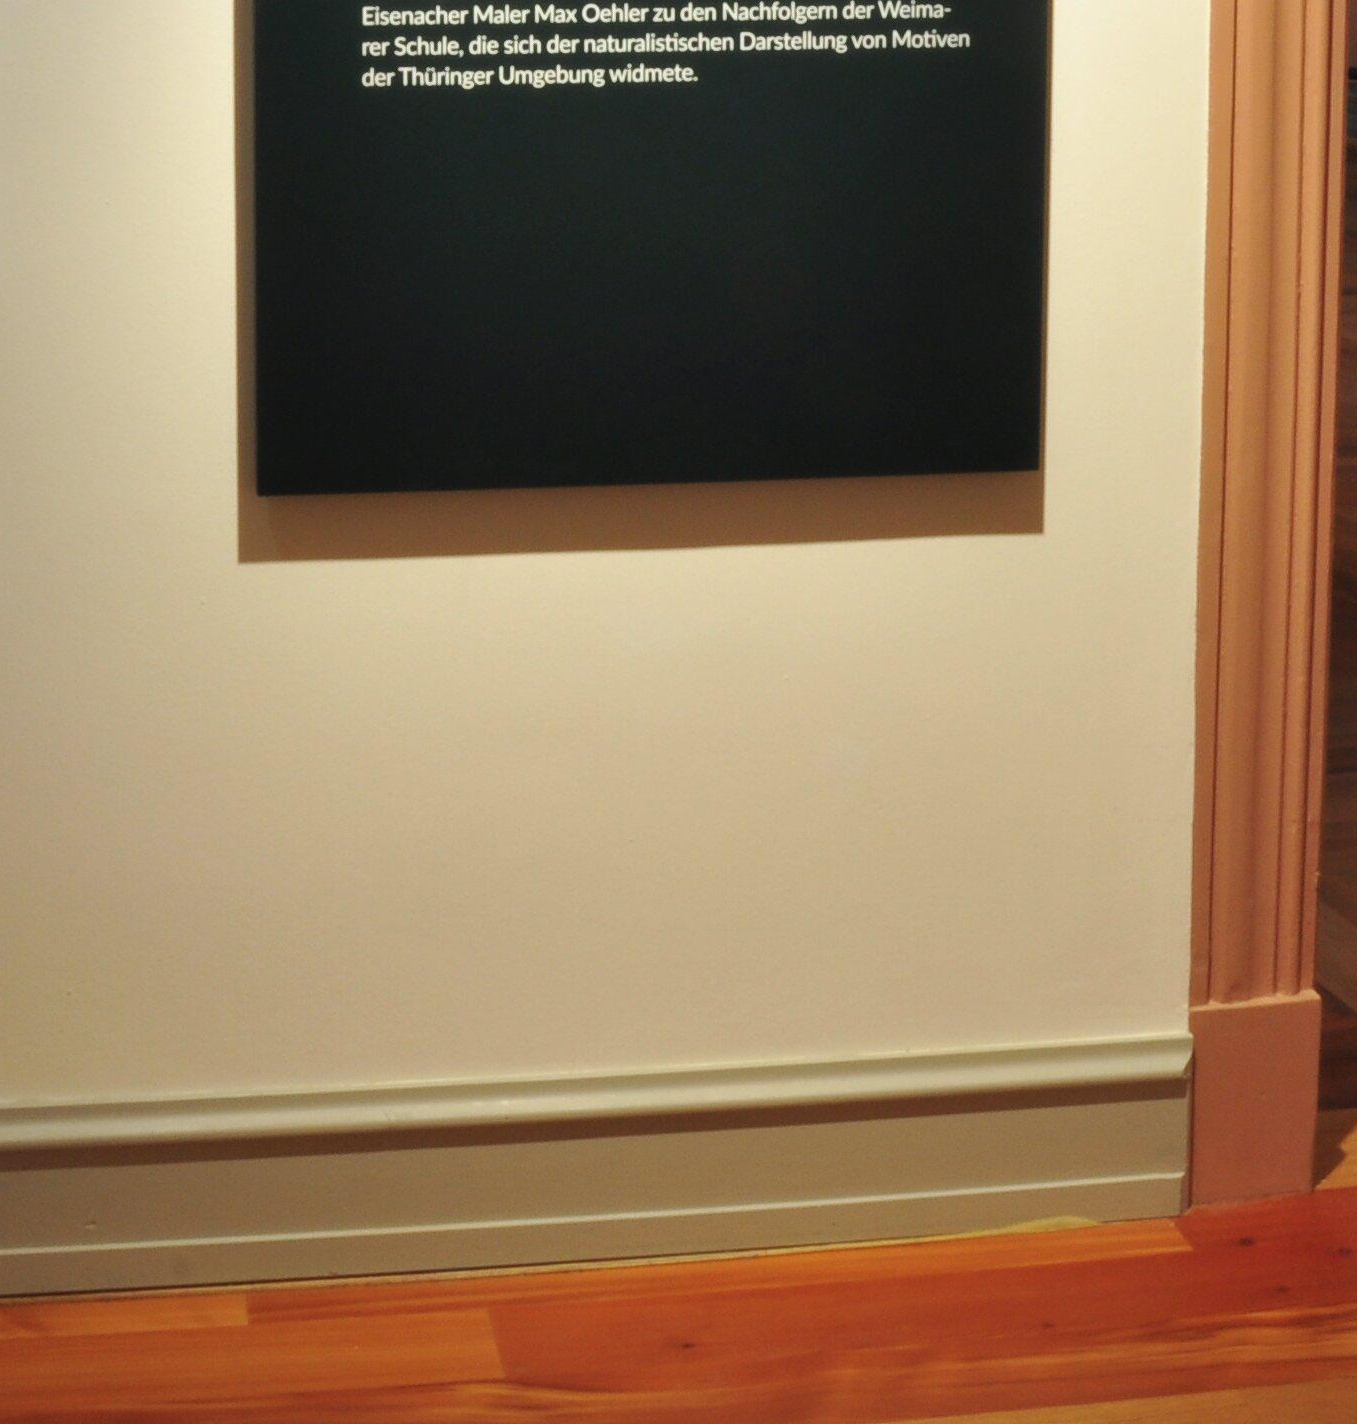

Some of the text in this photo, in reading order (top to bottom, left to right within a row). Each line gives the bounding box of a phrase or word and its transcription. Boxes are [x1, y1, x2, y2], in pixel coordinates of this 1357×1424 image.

[361, 0, 952, 27] Eisenacher Maler Max Oehler zu den Nachfolgern der Weima-
[361, 28, 971, 59] rer Schule, die sich der naturalistischen Darstellung von Motiven
[361, 62, 699, 91] der Thüringer Umgebung widmete.
